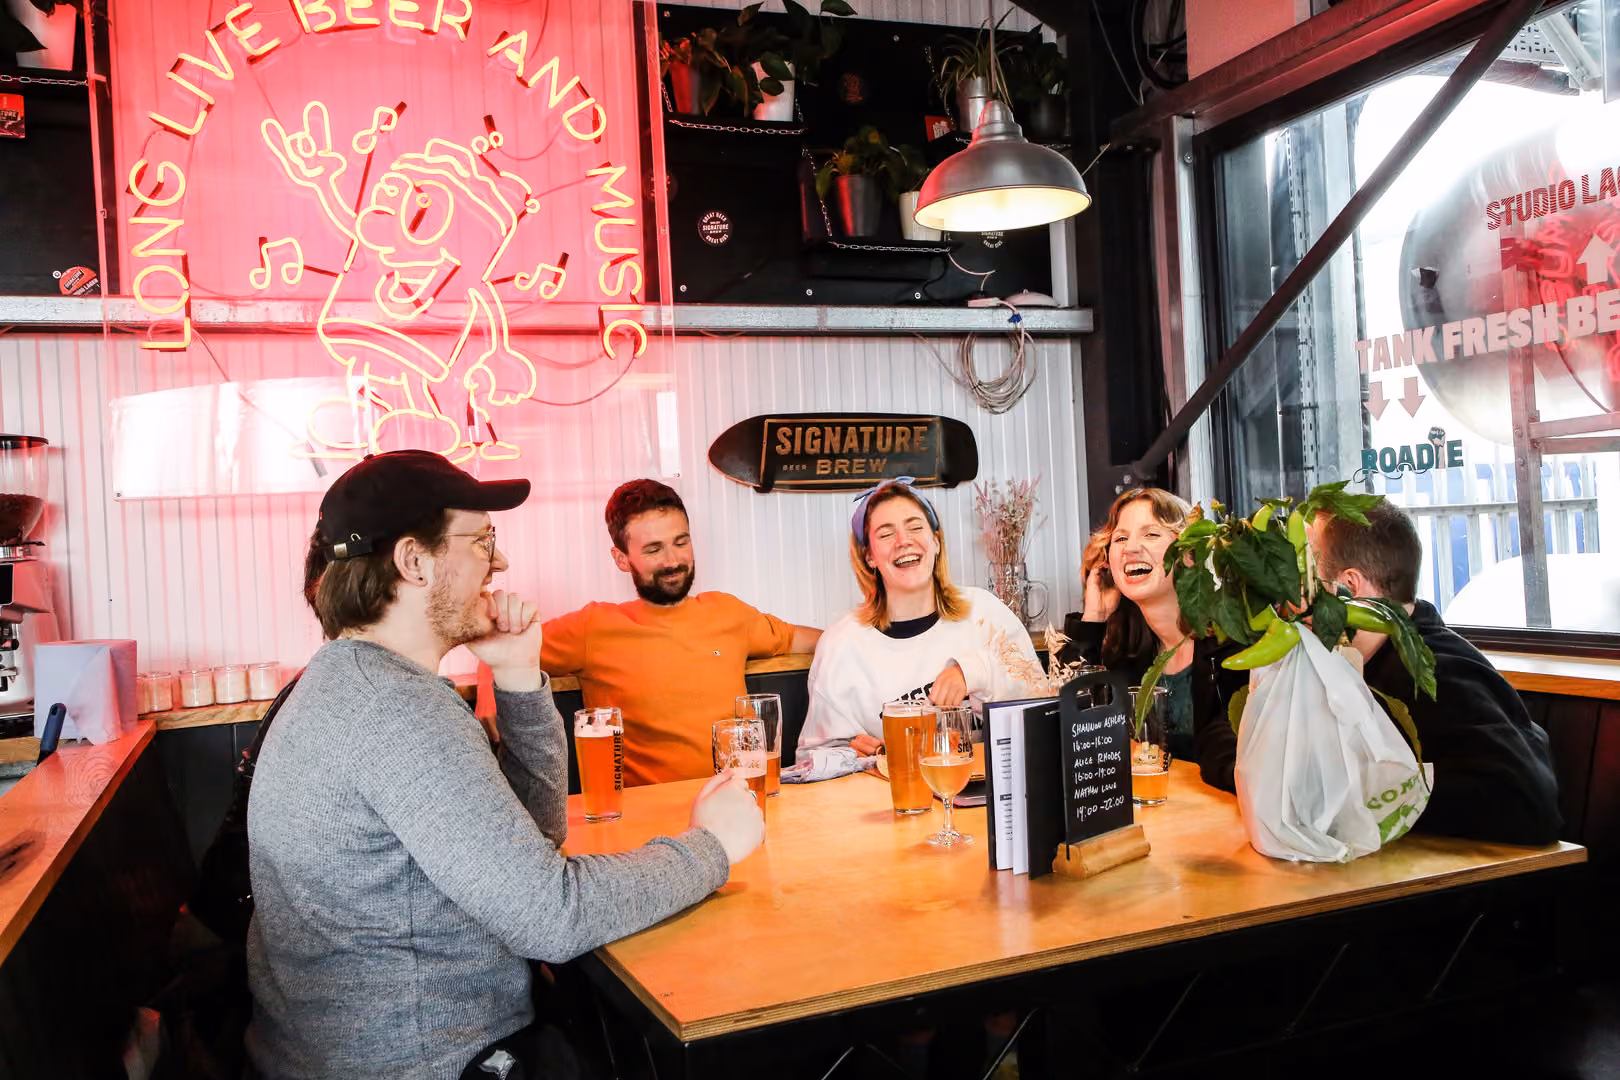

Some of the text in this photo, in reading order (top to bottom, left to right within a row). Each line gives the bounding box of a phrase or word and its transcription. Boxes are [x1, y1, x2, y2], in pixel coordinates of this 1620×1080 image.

[147, 2, 283, 138] LIVE
[487, 30, 607, 140] AND
[1486, 165, 1620, 231] STUDIO LA
[129, 159, 191, 349] LONG
[586, 165, 648, 360] MUSIC
[1354, 326, 1438, 372] TANK
[1442, 301, 1560, 361] FRESH
[776, 426, 929, 455] SIGNATURE
[816, 458, 888, 475] BREW
[1071, 713, 1126, 738] SHANNON ASHLEY
[613, 729, 622, 792] SIGNATURE
[1074, 751, 1122, 769] ALICE RHODES
[1074, 785, 1099, 799] NATHAN
